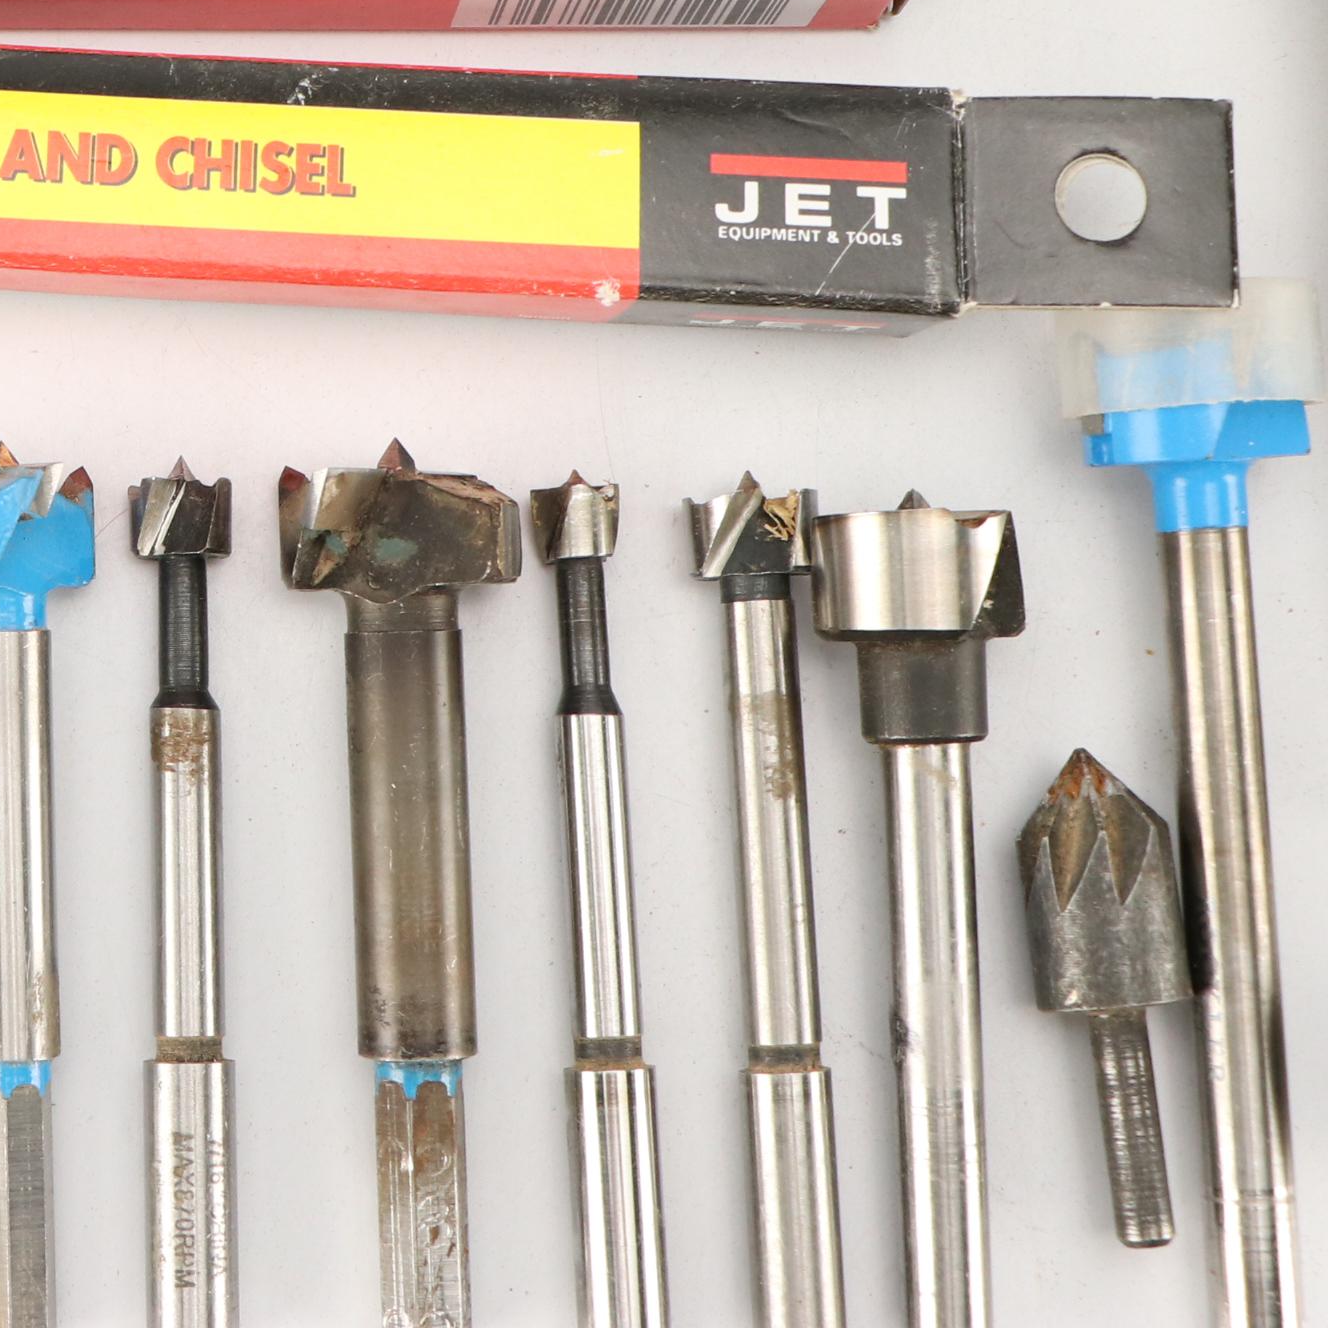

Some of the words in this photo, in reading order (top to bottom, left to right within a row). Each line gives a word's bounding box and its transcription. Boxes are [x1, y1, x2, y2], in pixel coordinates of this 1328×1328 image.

[155, 135, 356, 197] CHISEL
[714, 180, 908, 230] JET
[718, 225, 821, 243] EQUIPMENT
[827, 231, 840, 244] &
[846, 230, 903, 246] TOOLS
